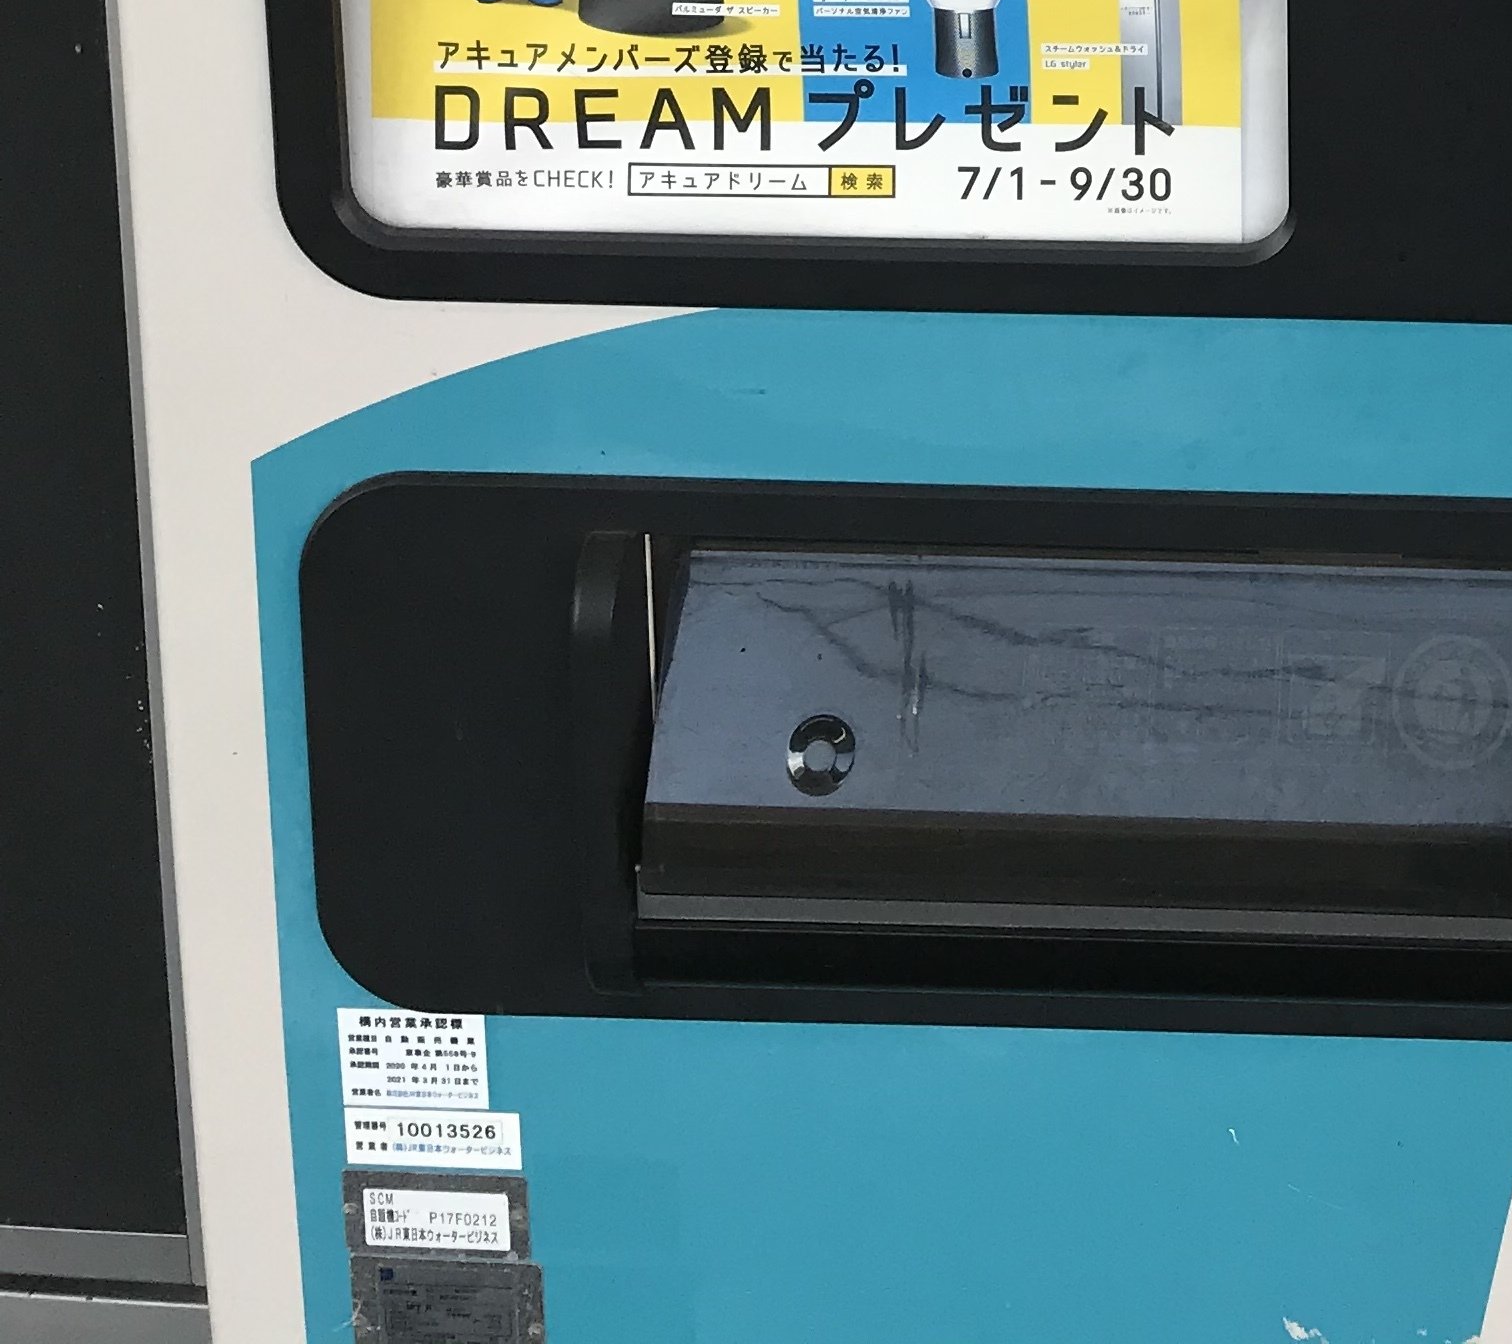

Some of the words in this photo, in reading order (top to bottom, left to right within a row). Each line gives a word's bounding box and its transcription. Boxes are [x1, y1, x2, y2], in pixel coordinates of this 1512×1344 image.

[437, 39, 899, 74] アキュアメンバーズ登録で当たる!
[434, 84, 772, 151] DREAM
[808, 77, 1176, 156] プレゼント
[435, 169, 614, 189] 豪華賞品をCHECK!
[639, 171, 808, 191] アキュアドリーム
[840, 171, 884, 191] 検索
[396, 1122, 497, 1140] 10013526
[369, 1192, 394, 1205] SCM
[428, 1211, 498, 1227] P17F0212
